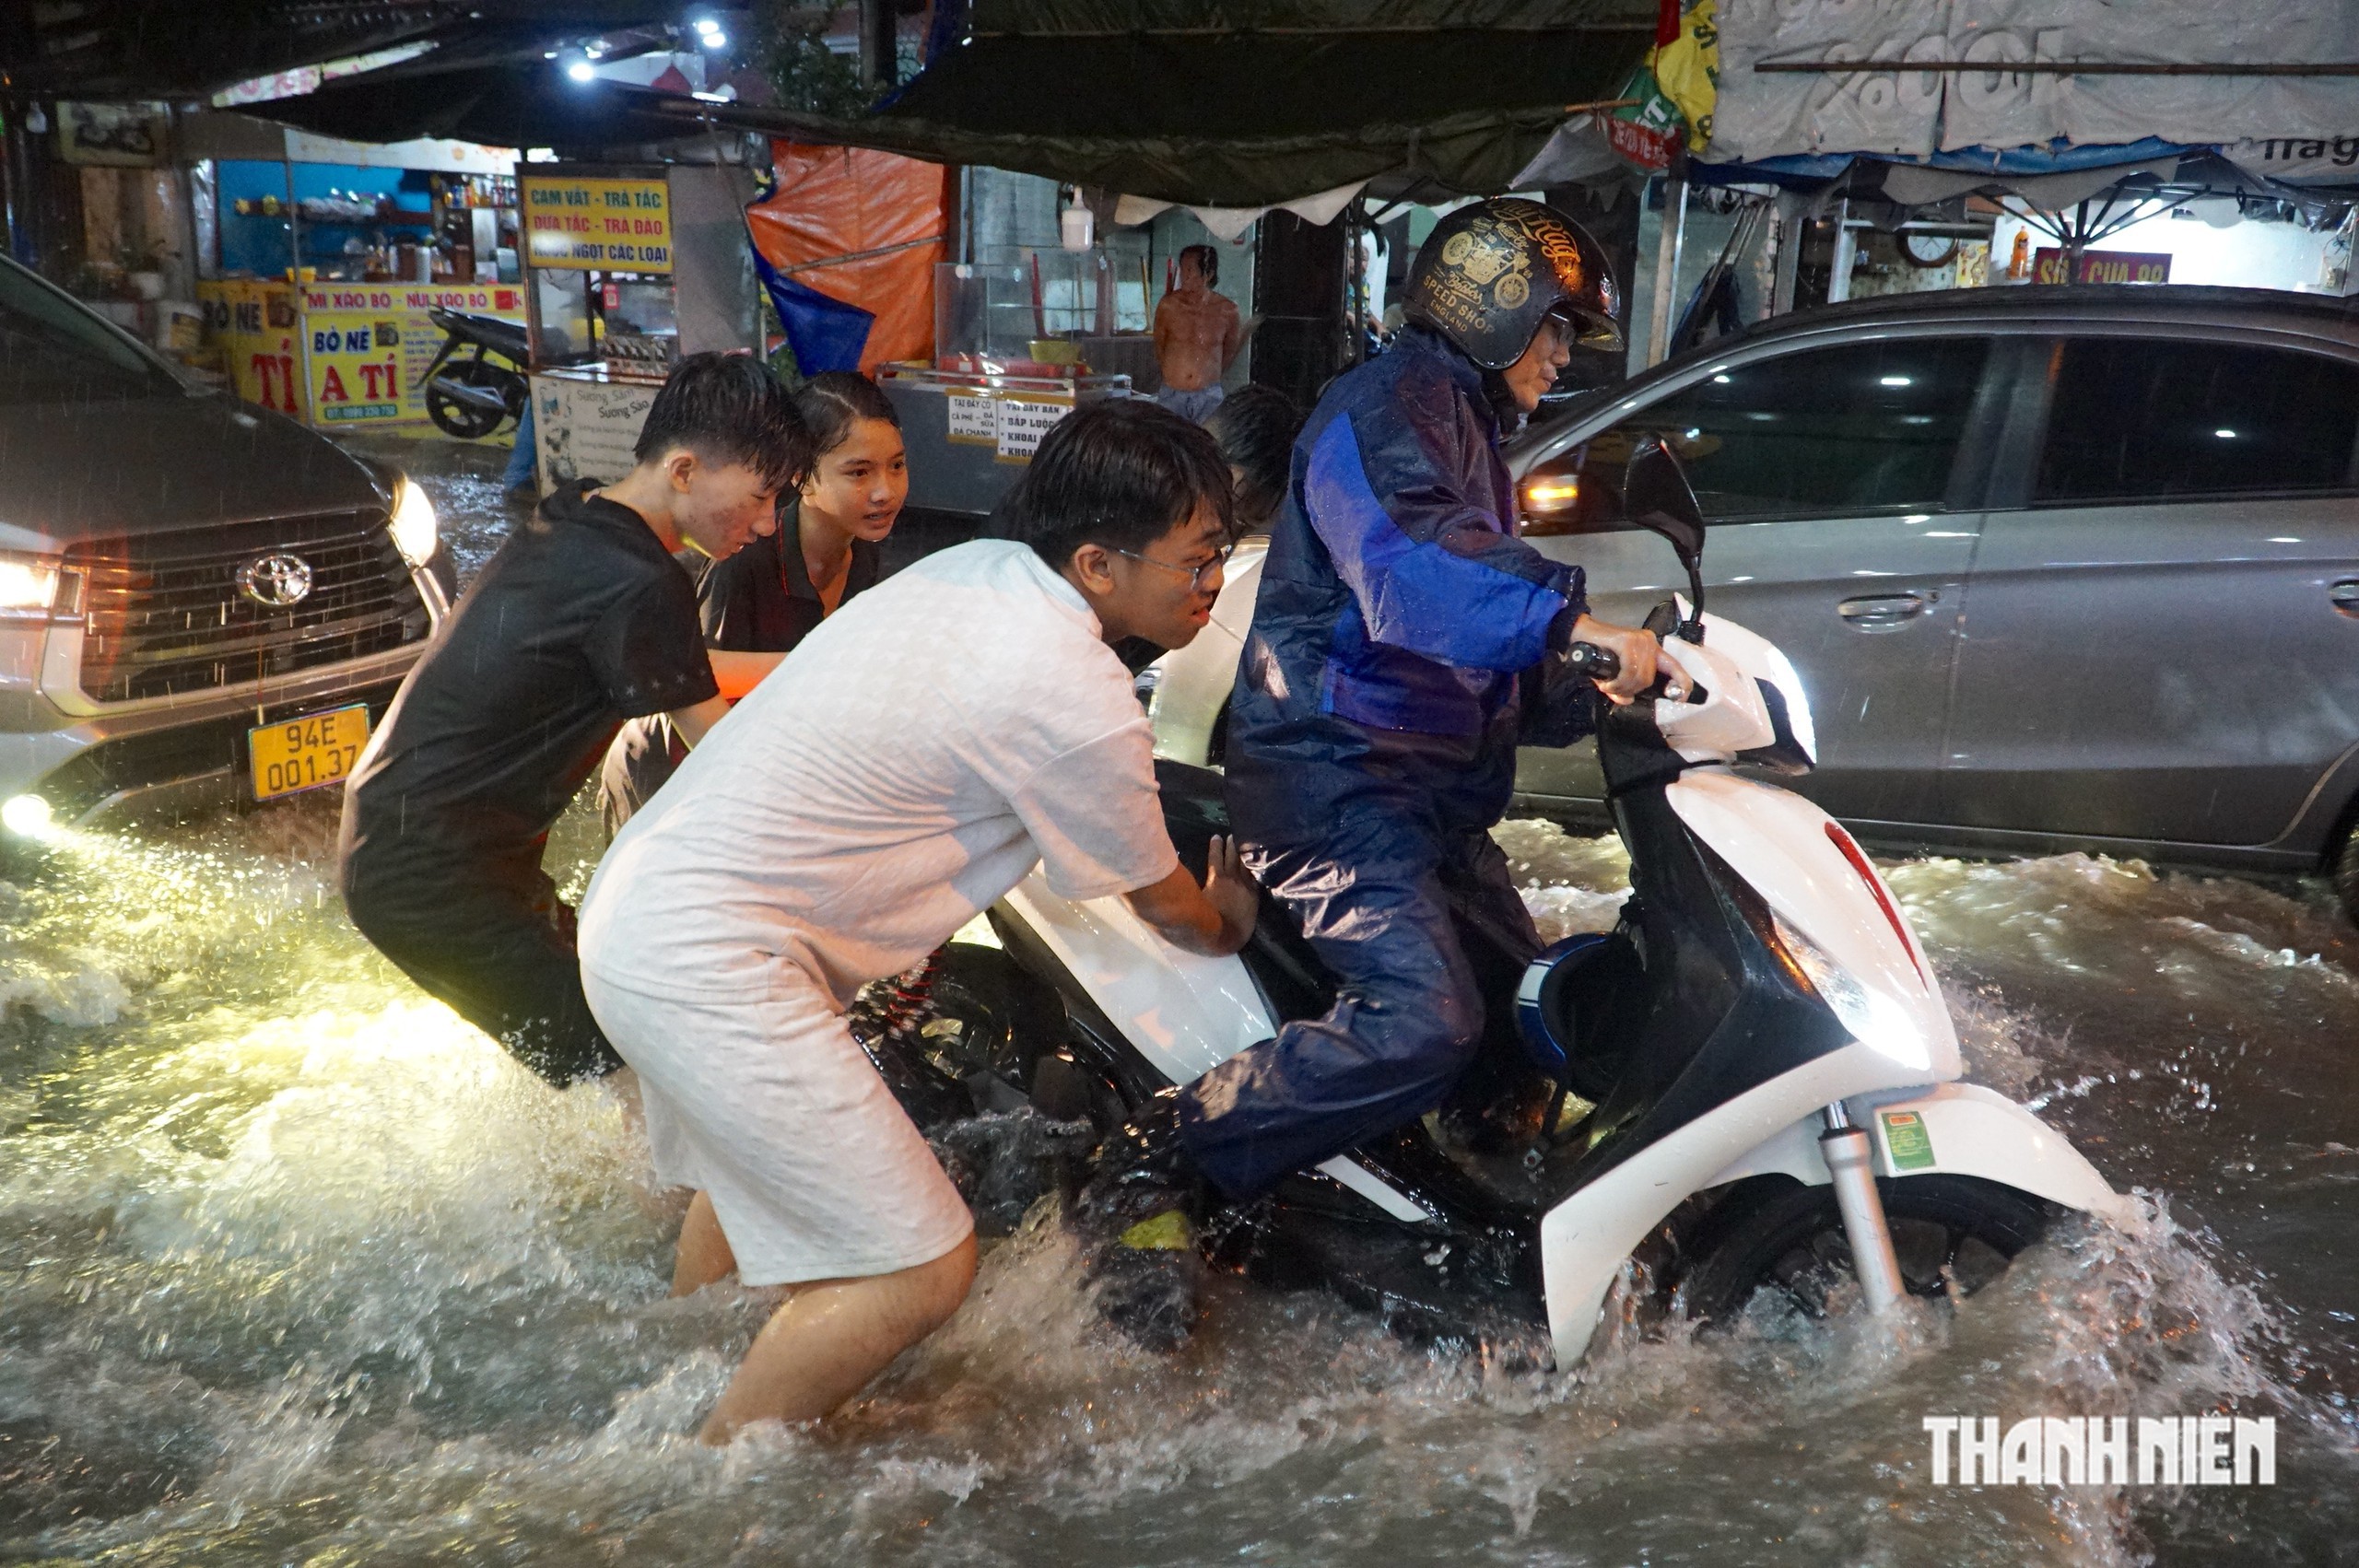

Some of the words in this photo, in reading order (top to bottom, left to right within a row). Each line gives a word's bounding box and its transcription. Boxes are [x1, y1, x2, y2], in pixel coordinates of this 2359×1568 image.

[604, 189, 630, 207] TRÀ
[634, 187, 662, 209] TẮC
[604, 216, 630, 234] TRÀ
[634, 216, 663, 236] ĐÀO
[572, 243, 604, 263] NGỌT
[608, 242, 635, 262] CÁC
[638, 246, 668, 265] LOẠI
[333, 290, 366, 309] XÀO
[370, 290, 392, 309] BÒ
[1422, 275, 1458, 309] SPEED
[1458, 303, 1496, 335] SHOP
[1429, 299, 1470, 333] ENGLAND
[314, 325, 342, 353] BÒ
[252, 338, 298, 414] TÍ
[320, 366, 349, 403] A
[358, 352, 399, 401] TÍ
[1007, 432, 1037, 443] KHOAI
[287, 716, 337, 754] 94E
[267, 744, 358, 792] 001.37
